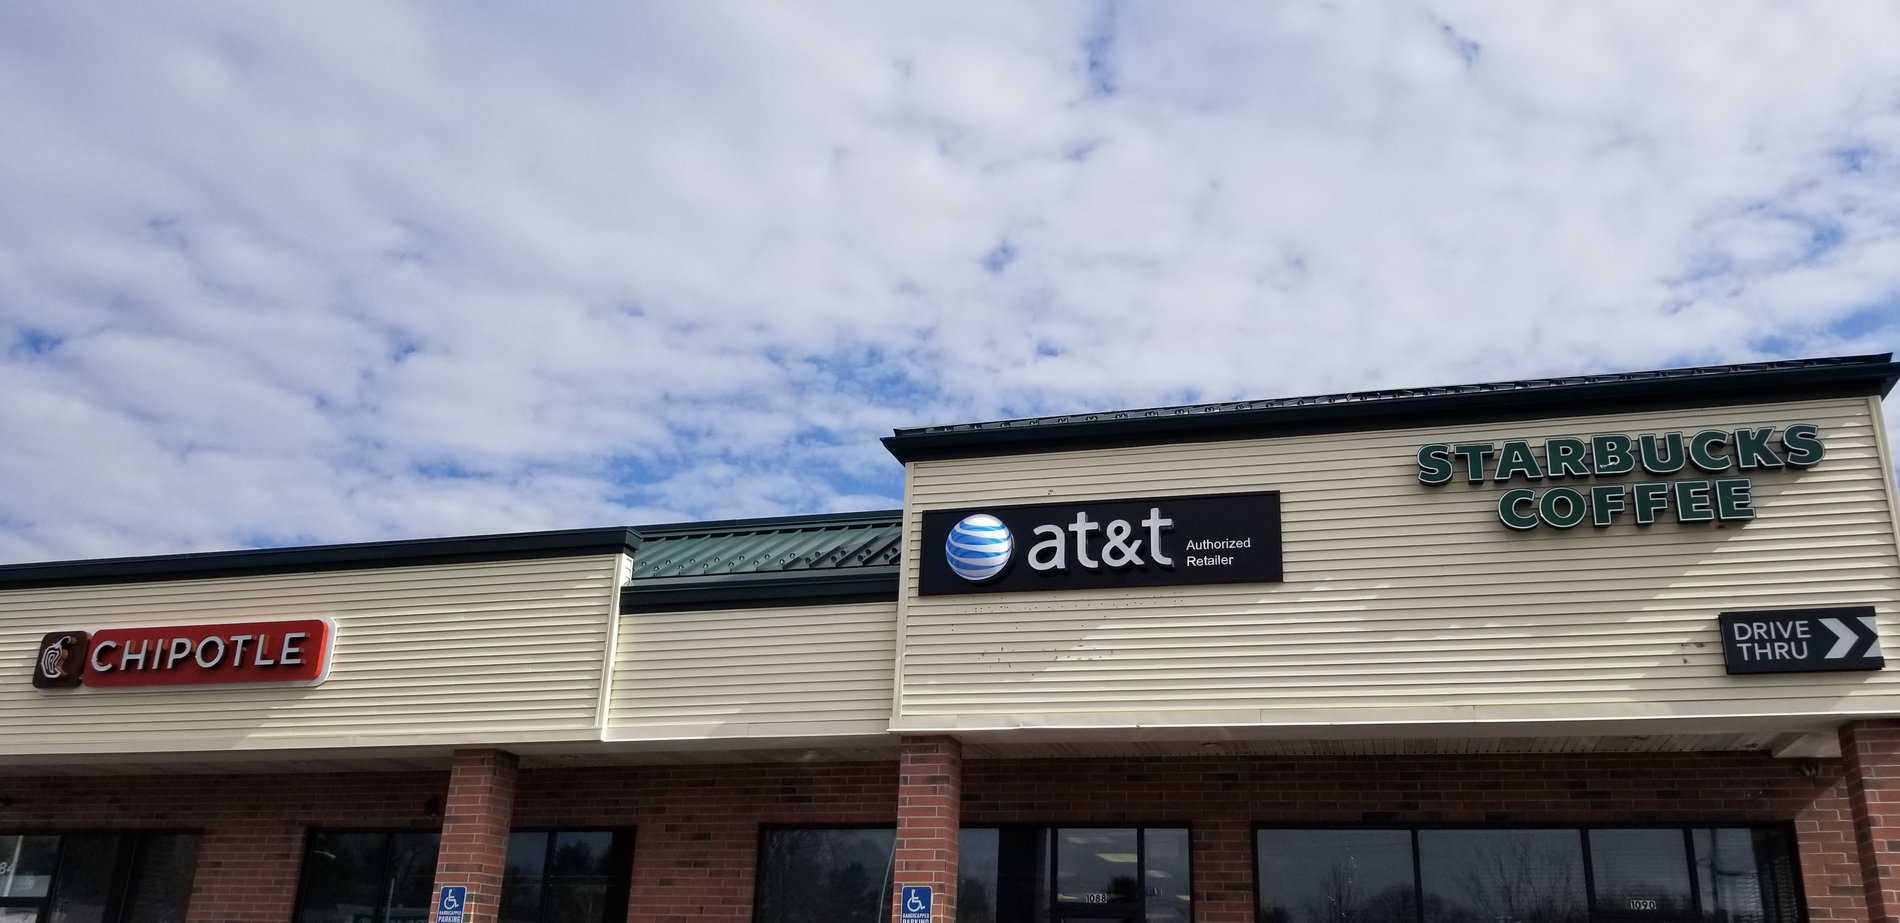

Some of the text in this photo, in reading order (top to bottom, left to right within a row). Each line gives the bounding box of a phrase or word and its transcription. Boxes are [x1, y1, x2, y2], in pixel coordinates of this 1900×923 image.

[1416, 424, 1826, 485] STARBUCKS
[1498, 477, 1756, 531] COFFEE
[1027, 507, 1174, 571] at&t
[1186, 537, 1251, 551] Authorized
[1186, 555, 1234, 567] Retailer
[1733, 620, 1812, 641] DRIVE
[91, 632, 309, 672] CHIPOTLE
[1736, 641, 1808, 661] THRU
[1086, 893, 1108, 904] 1088
[1630, 900, 1656, 910] 1090
